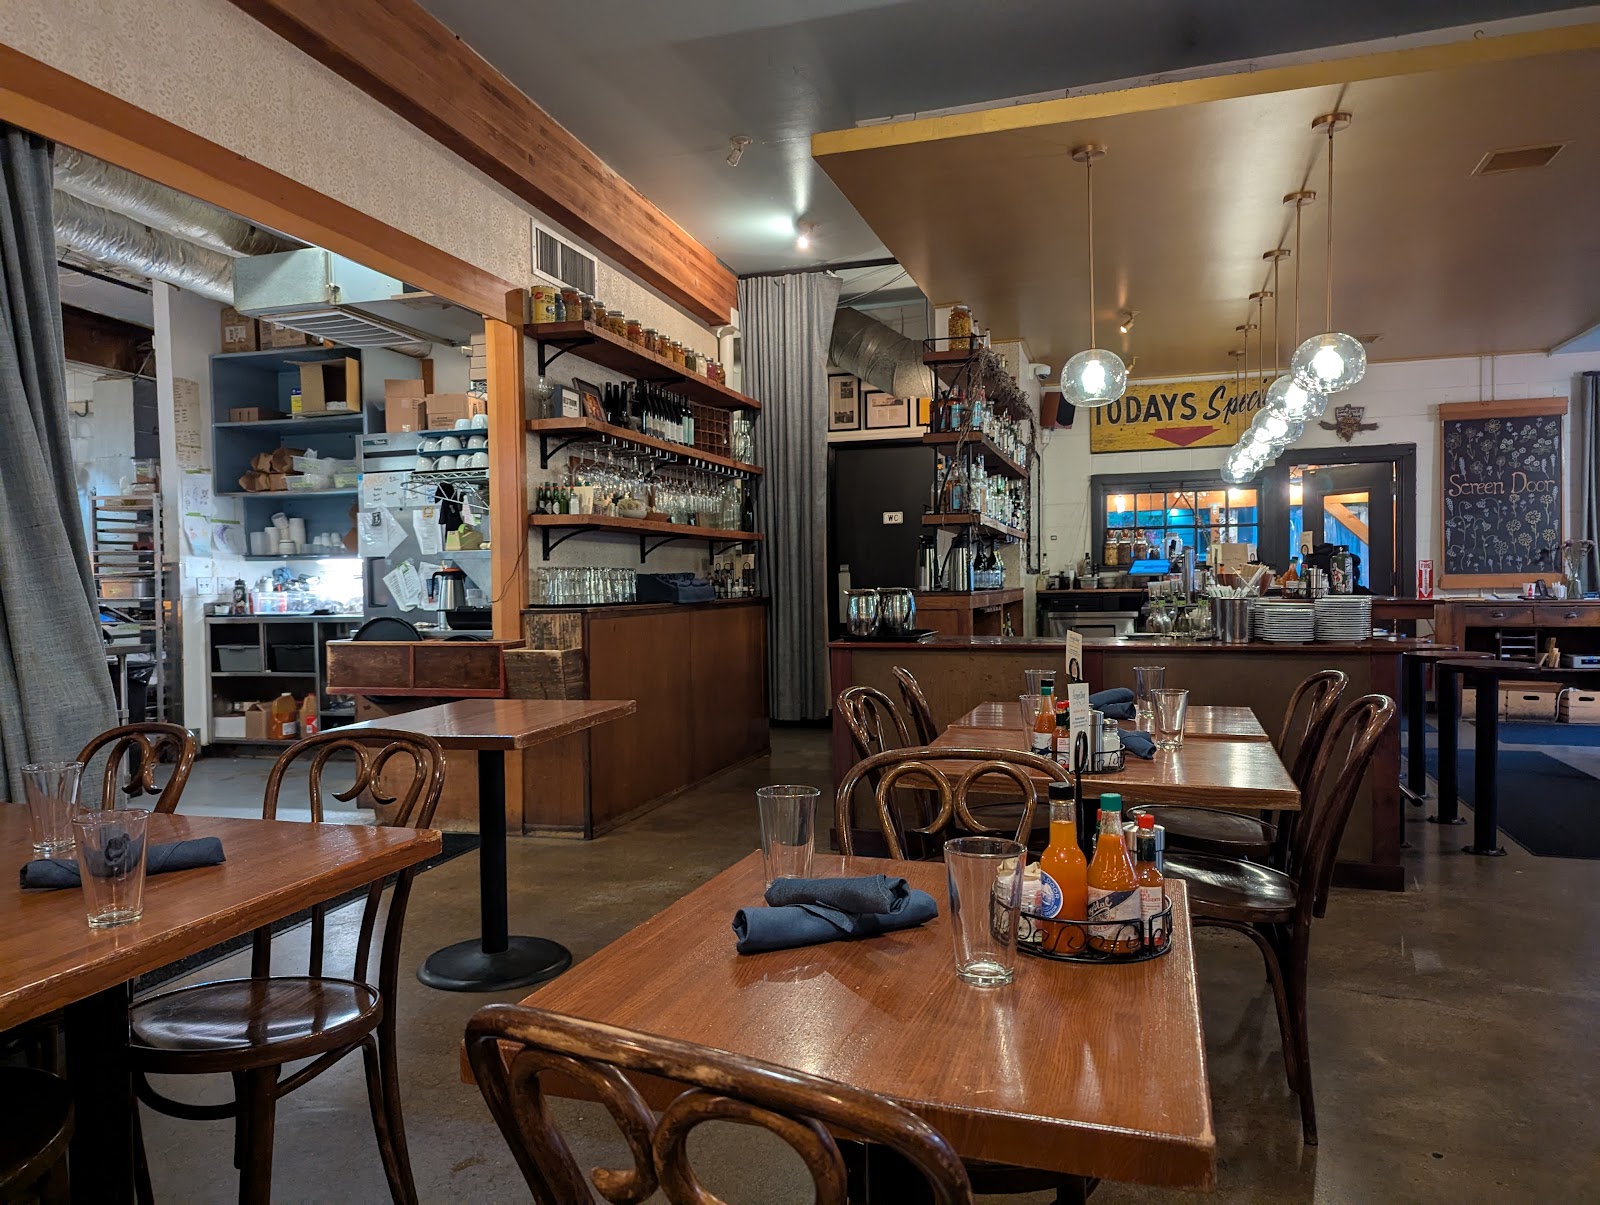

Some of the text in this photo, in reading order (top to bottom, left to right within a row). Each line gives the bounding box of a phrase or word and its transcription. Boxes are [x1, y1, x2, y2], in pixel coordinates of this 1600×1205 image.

[1203, 378, 1268, 425] Speci
[1448, 471, 1556, 497] Screen Door
[1046, 878, 1060, 899] DOOR
[1088, 896, 1112, 917] ystal
